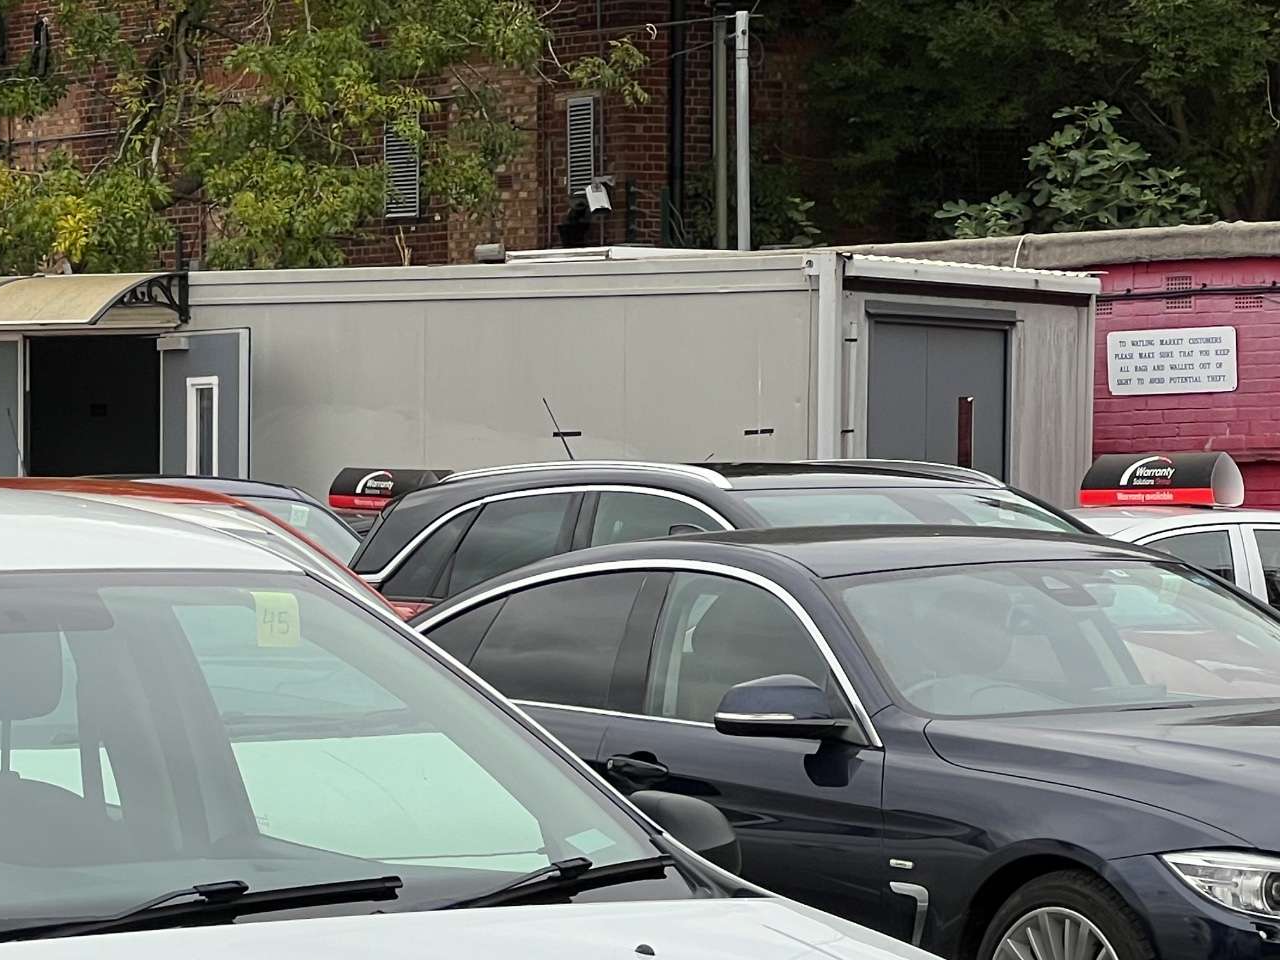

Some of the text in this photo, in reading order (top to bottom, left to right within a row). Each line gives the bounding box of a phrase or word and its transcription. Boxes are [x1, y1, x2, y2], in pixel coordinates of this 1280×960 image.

[1119, 340, 1126, 348] TO
[1160, 338, 1184, 346] MARKET
[1188, 336, 1222, 345] CUSTOMERS
[1114, 352, 1134, 360] PLEASE
[1138, 351, 1155, 359] MAKE
[1179, 350, 1194, 358] THAT
[1199, 349, 1210, 357] YOU
[1215, 348, 1230, 356] KEEP
[1119, 365, 1130, 373] ALL
[1169, 363, 1195, 371] WALLETS
[1199, 362, 1211, 370] OUT
[1168, 375, 1202, 384] POTENTIAL
[1207, 374, 1226, 382] THEFT
[1135, 466, 1176, 480] Warranty
[366, 479, 394, 491] Warranty
[262, 607, 290, 635] 45
